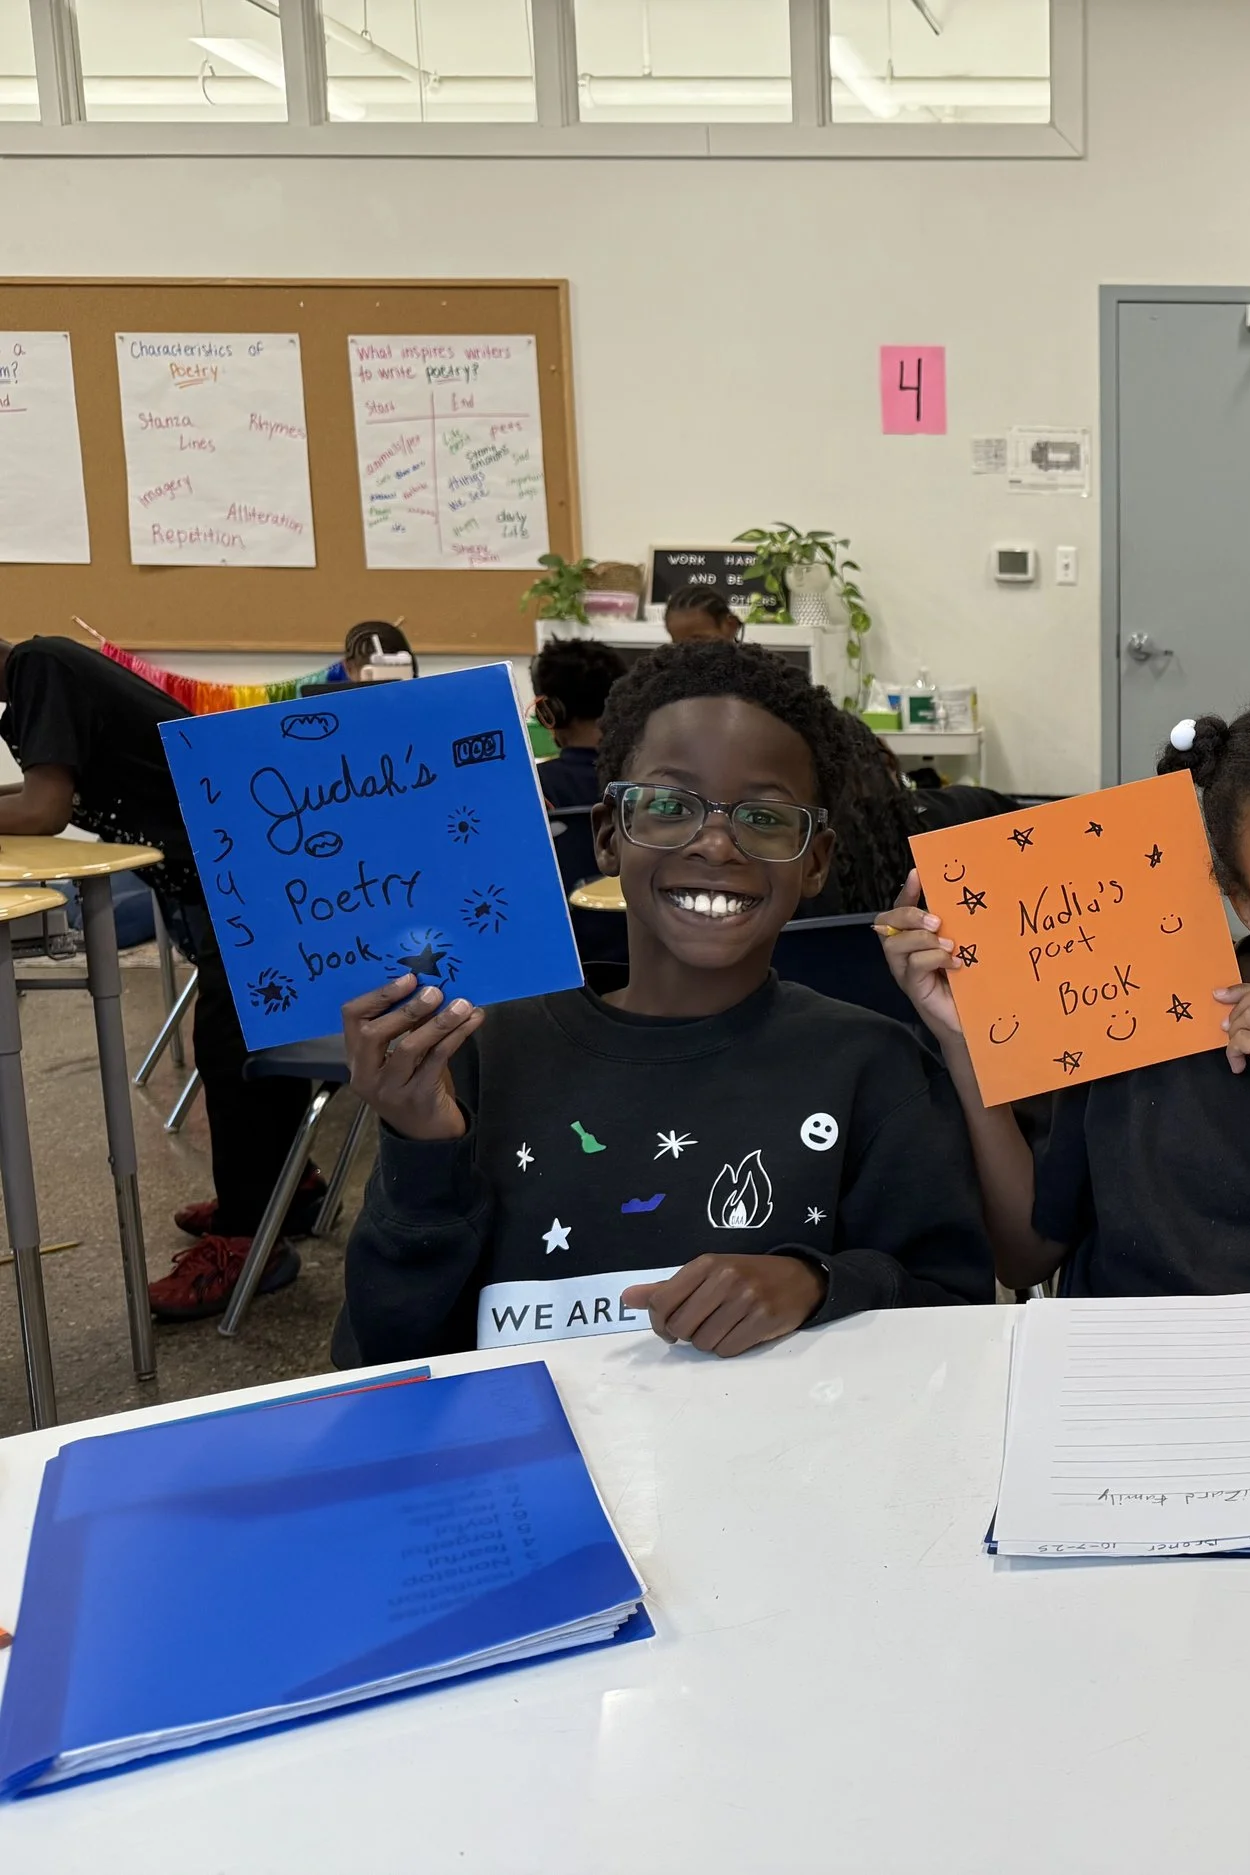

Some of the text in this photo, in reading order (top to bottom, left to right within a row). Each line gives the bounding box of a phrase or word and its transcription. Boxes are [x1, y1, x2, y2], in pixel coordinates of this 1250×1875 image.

[130, 340, 264, 359] Characteristics of
[356, 345, 511, 363] What inspires writers
[169, 362, 218, 382] Poetry
[357, 362, 480, 384] to write poetry?
[899, 358, 922, 422] 4
[138, 412, 195, 430] Stanza
[249, 412, 306, 440] Rhymes
[179, 434, 216, 453] Lines
[667, 554, 706, 566] WORK
[688, 573, 744, 586] AND BE
[250, 744, 438, 855] Judah's
[213, 829, 233, 862] 3
[216, 870, 246, 904] 4
[284, 861, 422, 925] Poetry
[1018, 879, 1124, 937] Nadia's
[226, 915, 255, 947] 5
[298, 936, 383, 982] book
[1028, 926, 1097, 982] poet
[491, 1296, 637, 1333] WE ARE
[401, 1556, 512, 1588] Nonstop
